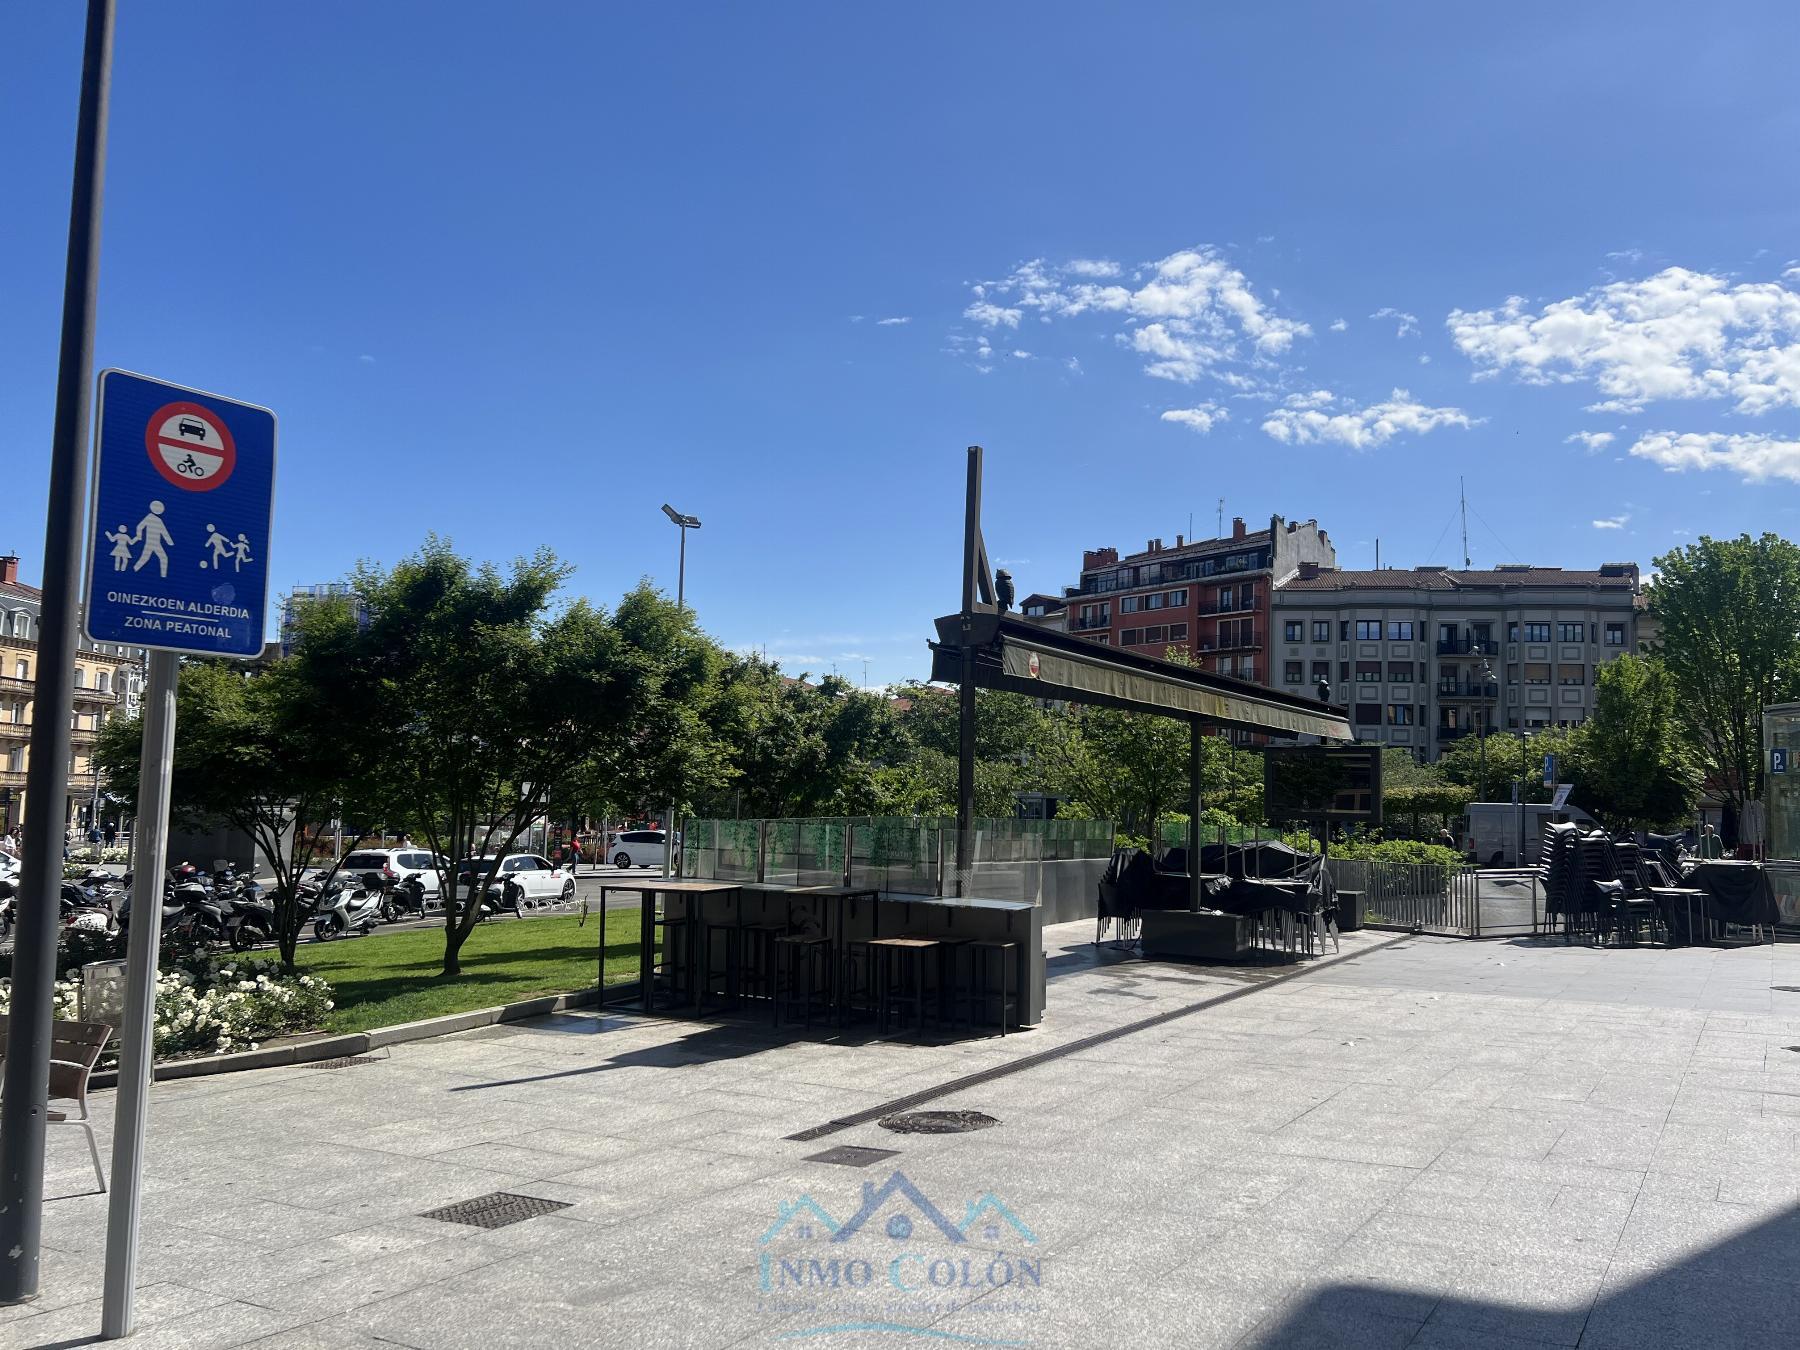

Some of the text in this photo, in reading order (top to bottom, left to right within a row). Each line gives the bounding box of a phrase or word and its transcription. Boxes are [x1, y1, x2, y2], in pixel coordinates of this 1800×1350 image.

[107, 591, 250, 619] OINEZKOEN ALDERDIA
[124, 616, 232, 638] ZONA PEATONAL
